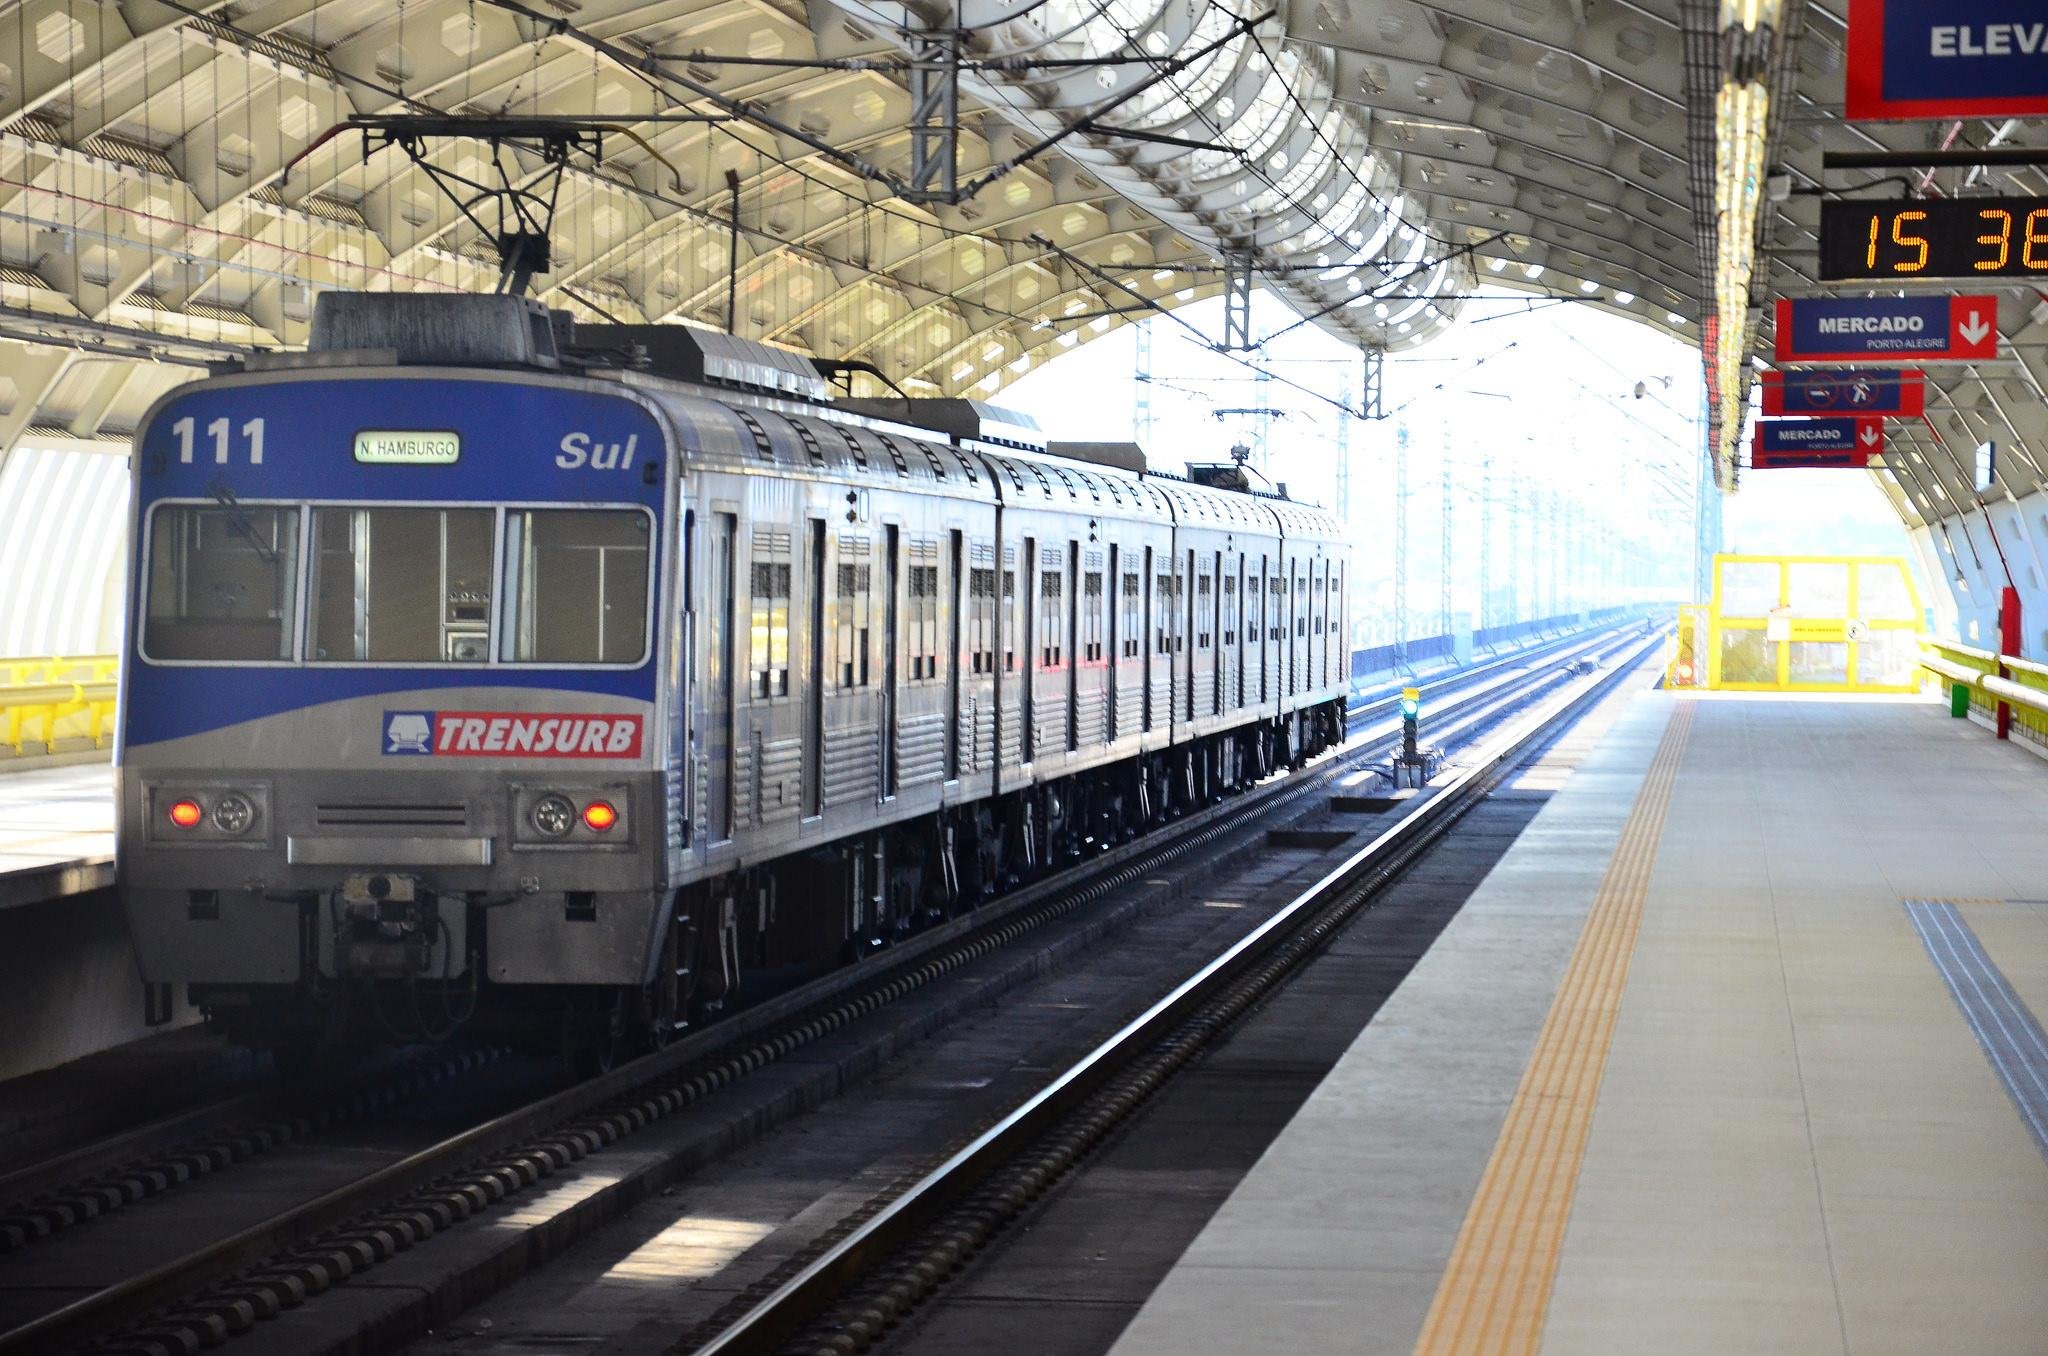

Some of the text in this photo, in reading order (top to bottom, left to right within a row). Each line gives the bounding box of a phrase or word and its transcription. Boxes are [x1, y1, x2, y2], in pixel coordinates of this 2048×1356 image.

[1931, 23, 2048, 57] ELEV
[1867, 211, 1928, 271] 15
[1818, 316, 1924, 334] MERCADO
[1866, 338, 1945, 350] PORTO ALEGRE
[172, 416, 265, 464] 111
[360, 440, 456, 456] N. HAMBURGO
[555, 431, 638, 470] Sul
[1778, 429, 1842, 440] MERCADO
[438, 717, 636, 753] TRENSURB
